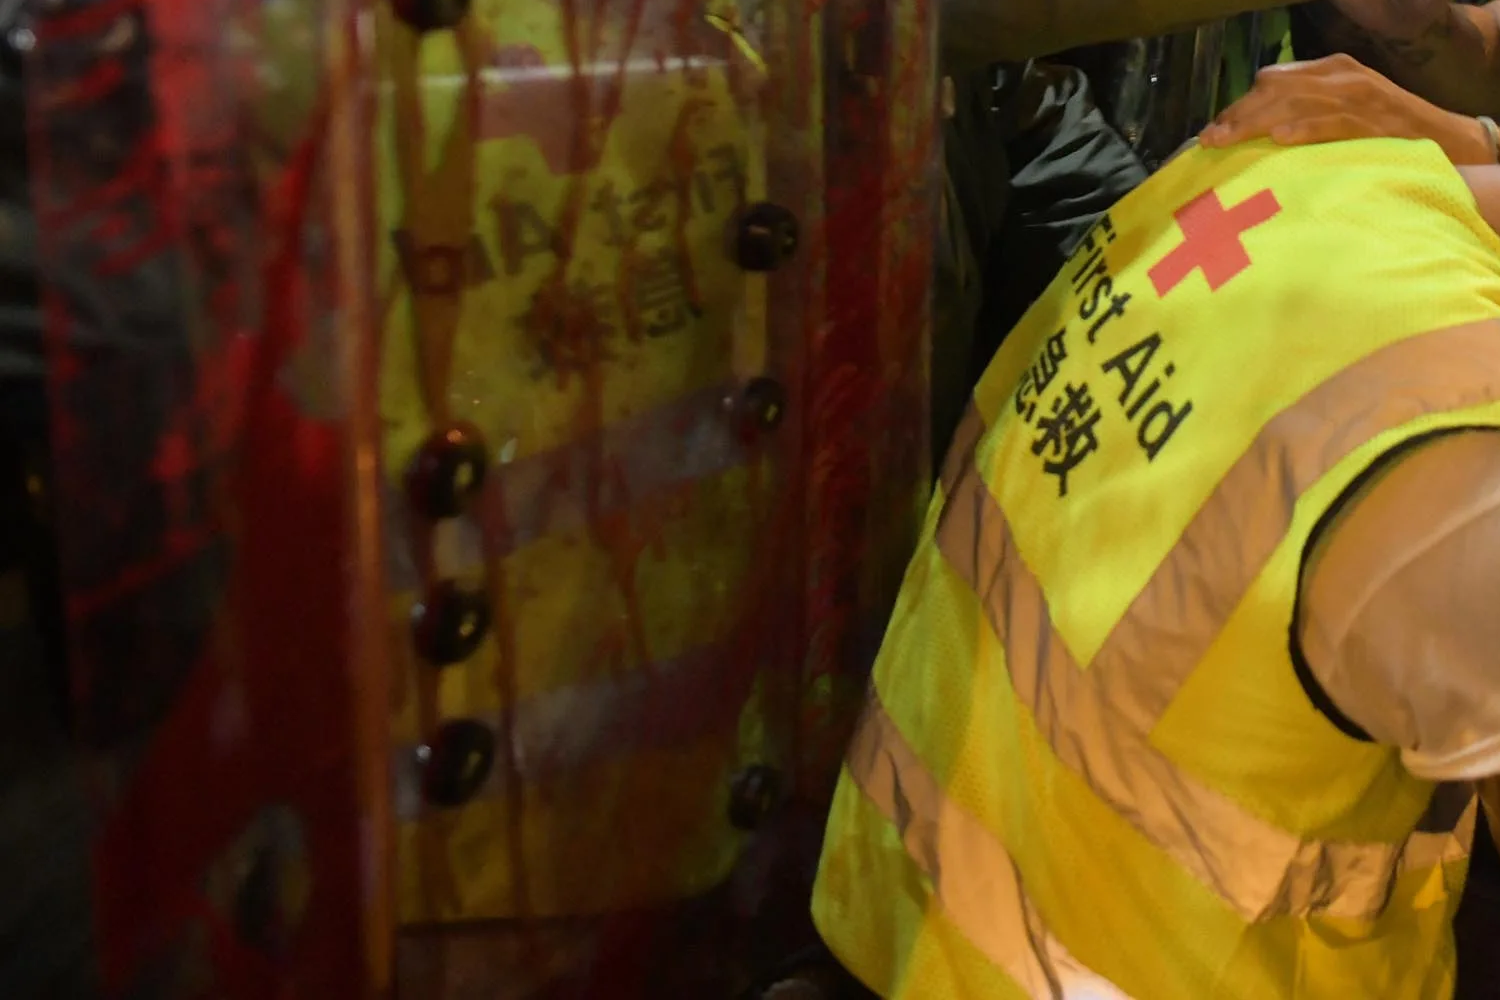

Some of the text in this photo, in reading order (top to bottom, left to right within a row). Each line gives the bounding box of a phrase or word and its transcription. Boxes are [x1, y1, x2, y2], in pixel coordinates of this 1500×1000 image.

[1014, 328, 1102, 497] 急救
[1066, 213, 1193, 463] First Aid
